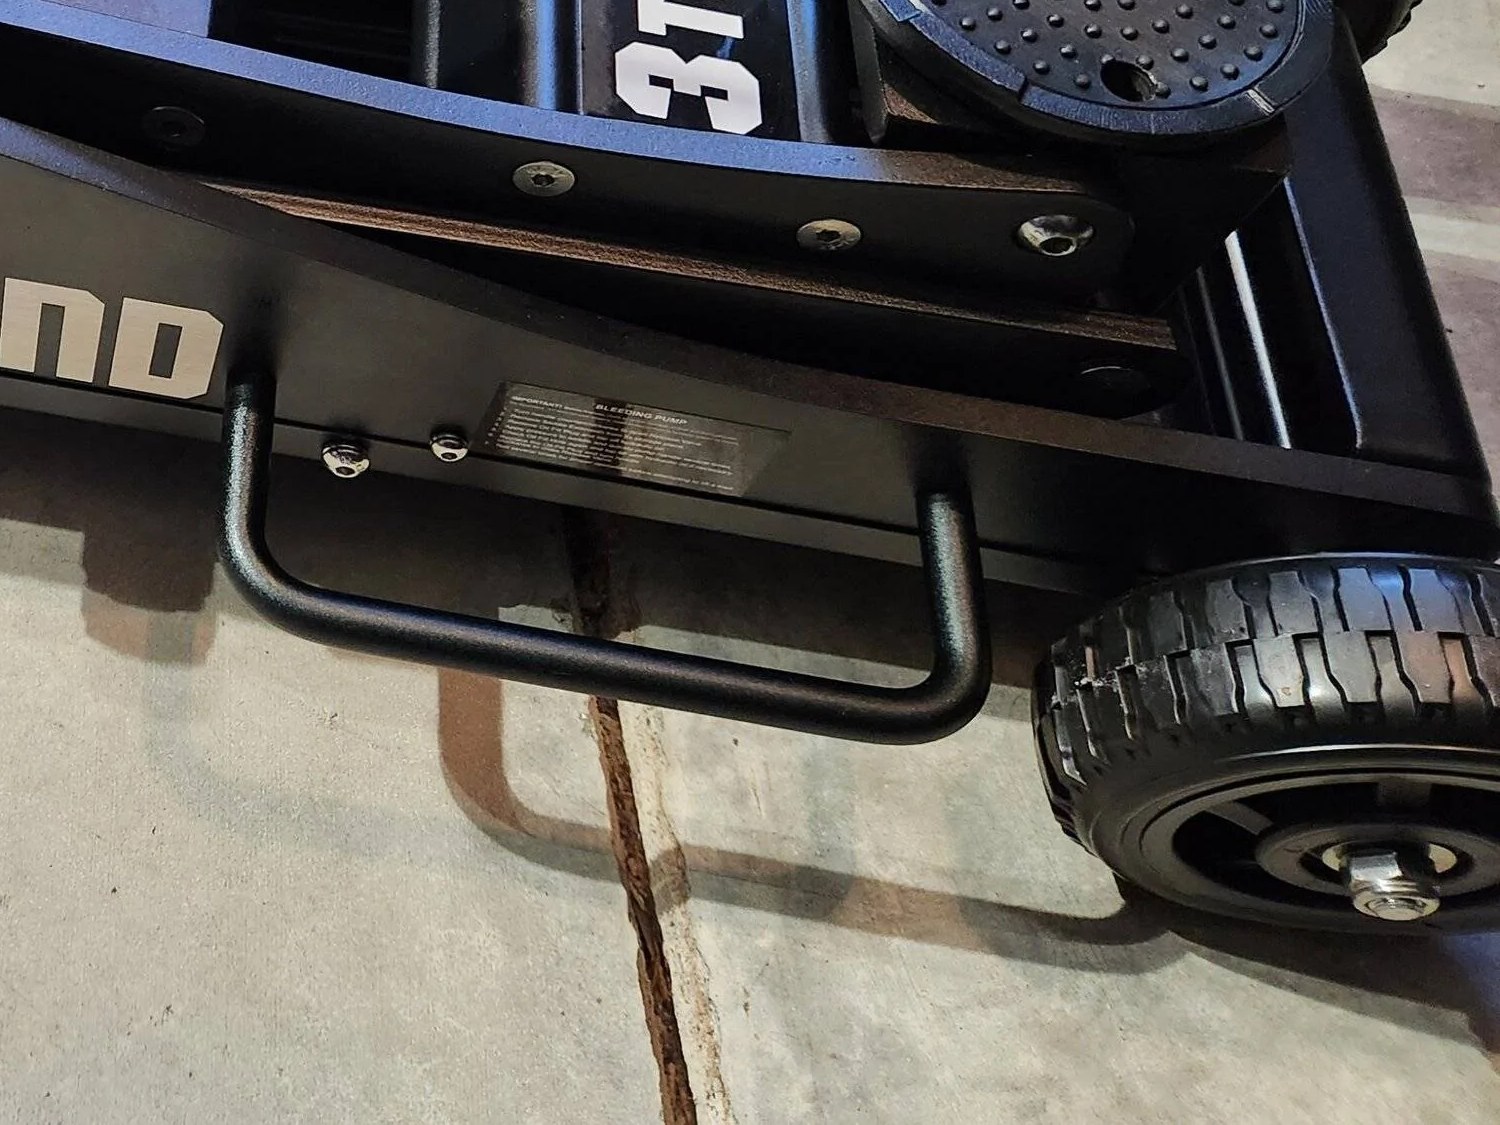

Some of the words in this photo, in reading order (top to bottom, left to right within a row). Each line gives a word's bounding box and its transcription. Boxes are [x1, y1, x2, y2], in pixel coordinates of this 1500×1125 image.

[615, 41, 762, 135] 3
[595, 403, 652, 419] BLEEDING
[654, 414, 689, 425] PUMP
